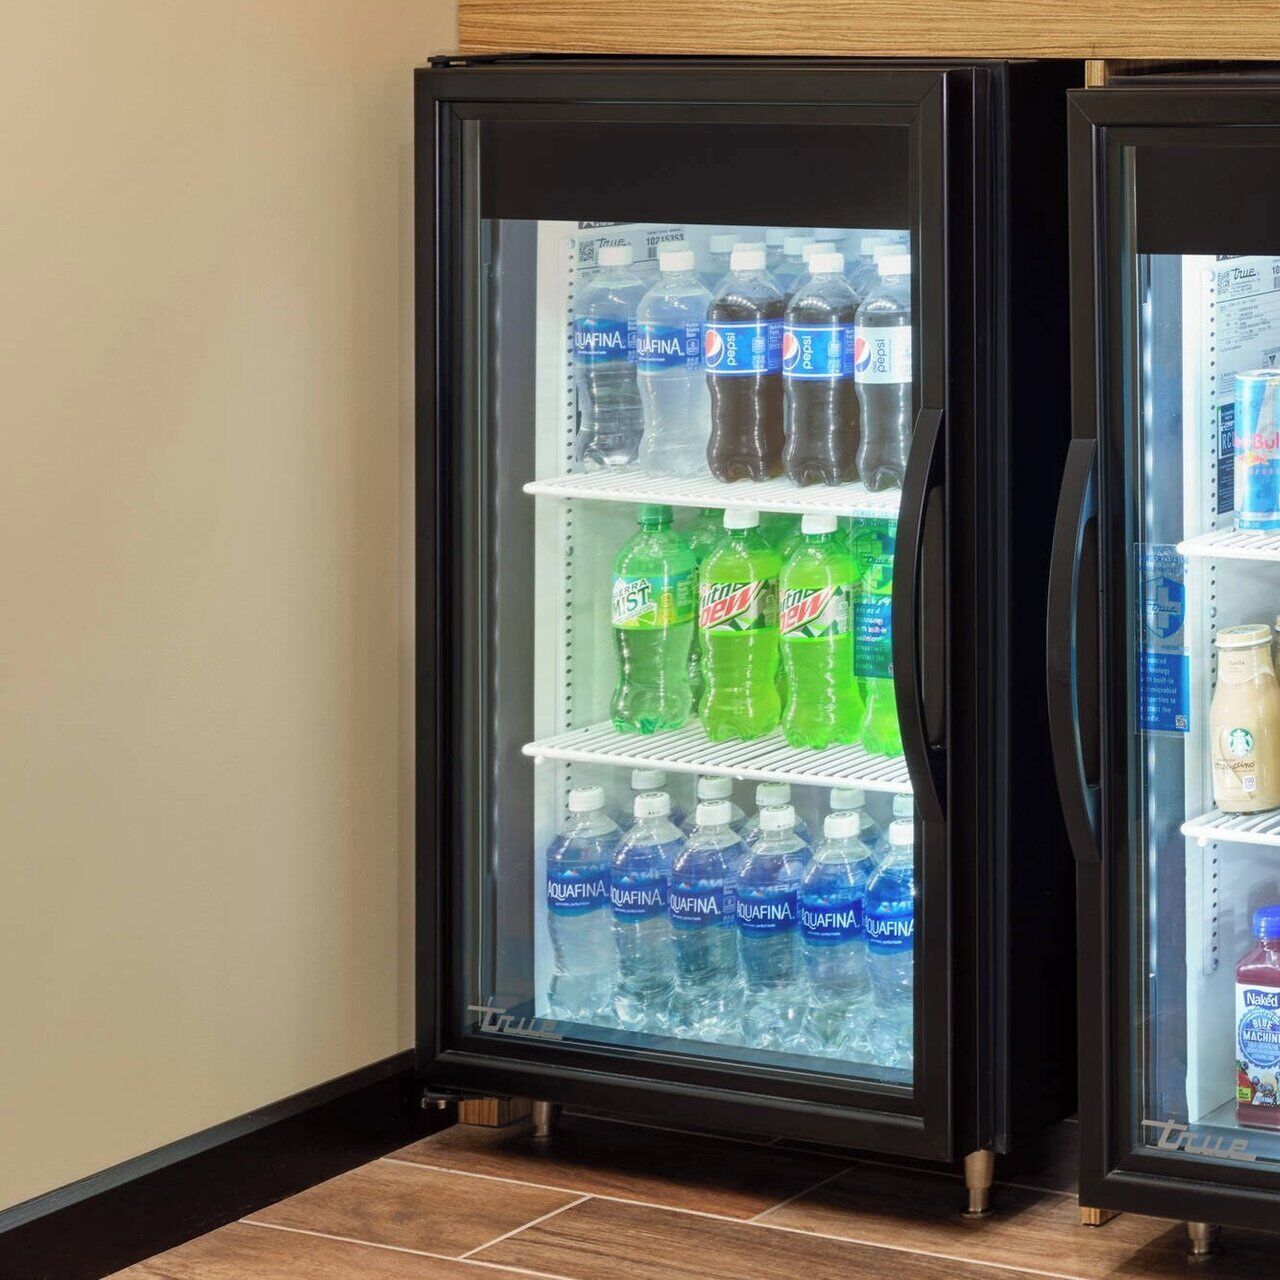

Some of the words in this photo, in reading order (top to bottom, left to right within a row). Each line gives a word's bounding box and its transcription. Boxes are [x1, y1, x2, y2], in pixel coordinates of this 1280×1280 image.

[726, 332, 738, 366] pepsi
[802, 335, 814, 370] pepsi
[878, 338, 888, 373] pepsi
[612, 587, 651, 616] MIST
[547, 880, 608, 902] AQUAFINA
[737, 901, 795, 922] AQUAFINA
[802, 908, 860, 930] AQUAFINA
[1246, 993, 1279, 1007] Naked
[1253, 1020, 1273, 1030] BLUE
